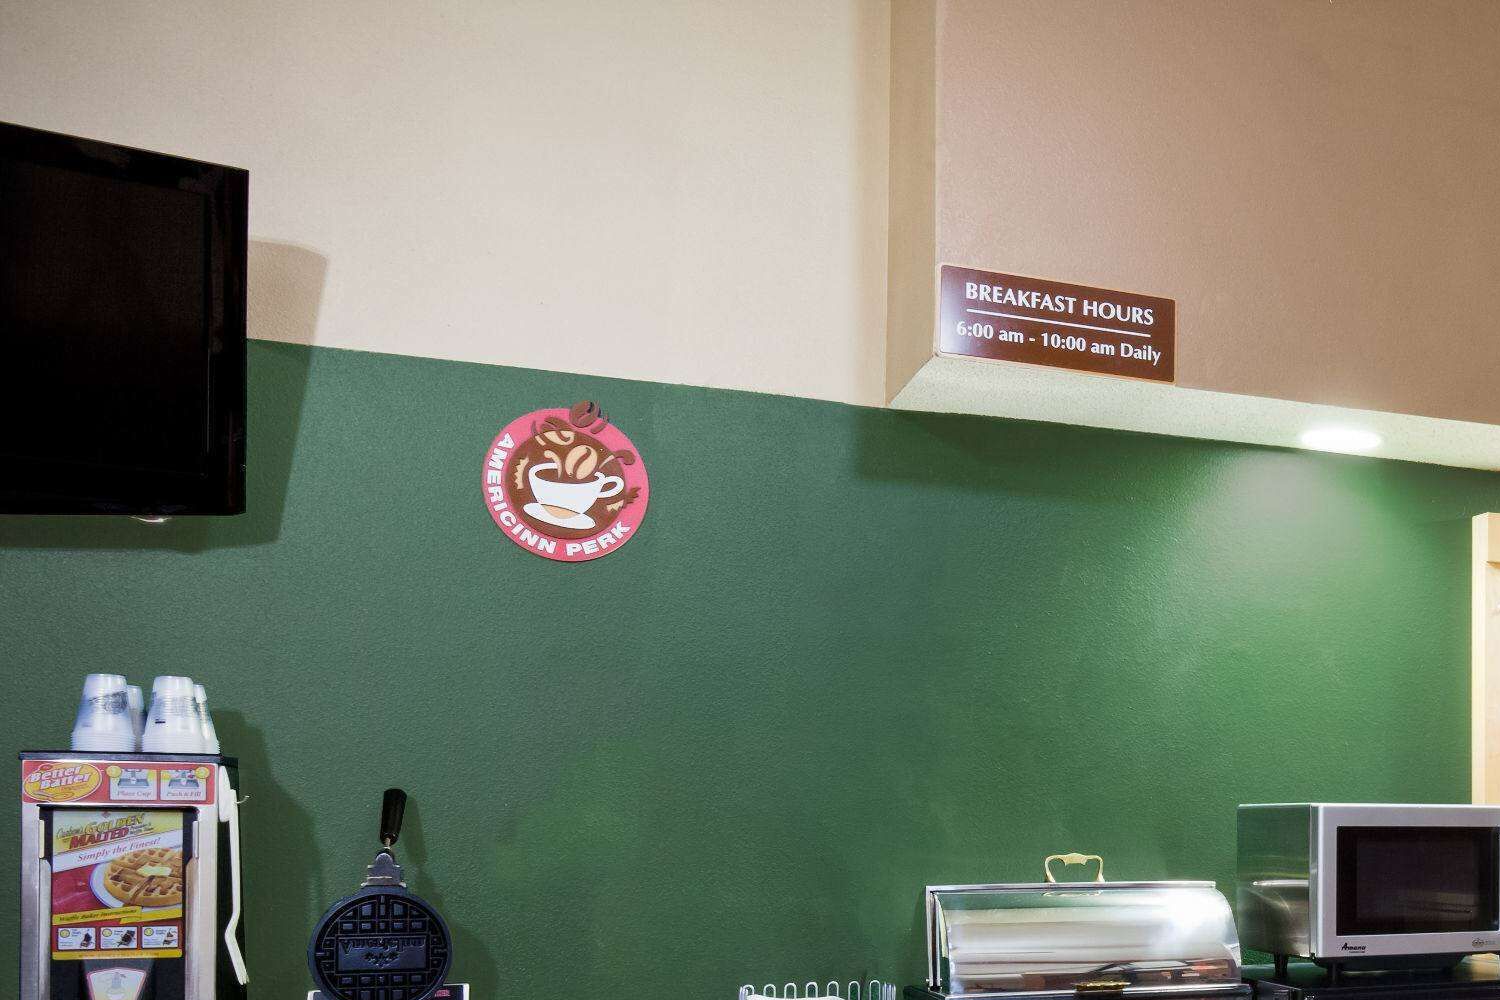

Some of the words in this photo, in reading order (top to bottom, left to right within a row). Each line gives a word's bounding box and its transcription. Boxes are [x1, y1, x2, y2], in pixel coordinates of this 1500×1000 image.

[965, 282, 1077, 314] BREAKFAST
[1082, 299, 1154, 326] HOURS
[956, 320, 994, 339] 6:00
[998, 330, 1024, 344] am
[1040, 332, 1087, 352] 10:00
[1090, 342, 1115, 356] am
[1120, 342, 1161, 367] Daily
[487, 433, 557, 554] AMERICINN
[565, 521, 631, 556] PERK
[77, 848, 111, 861] Simply
[113, 844, 127, 854] the
